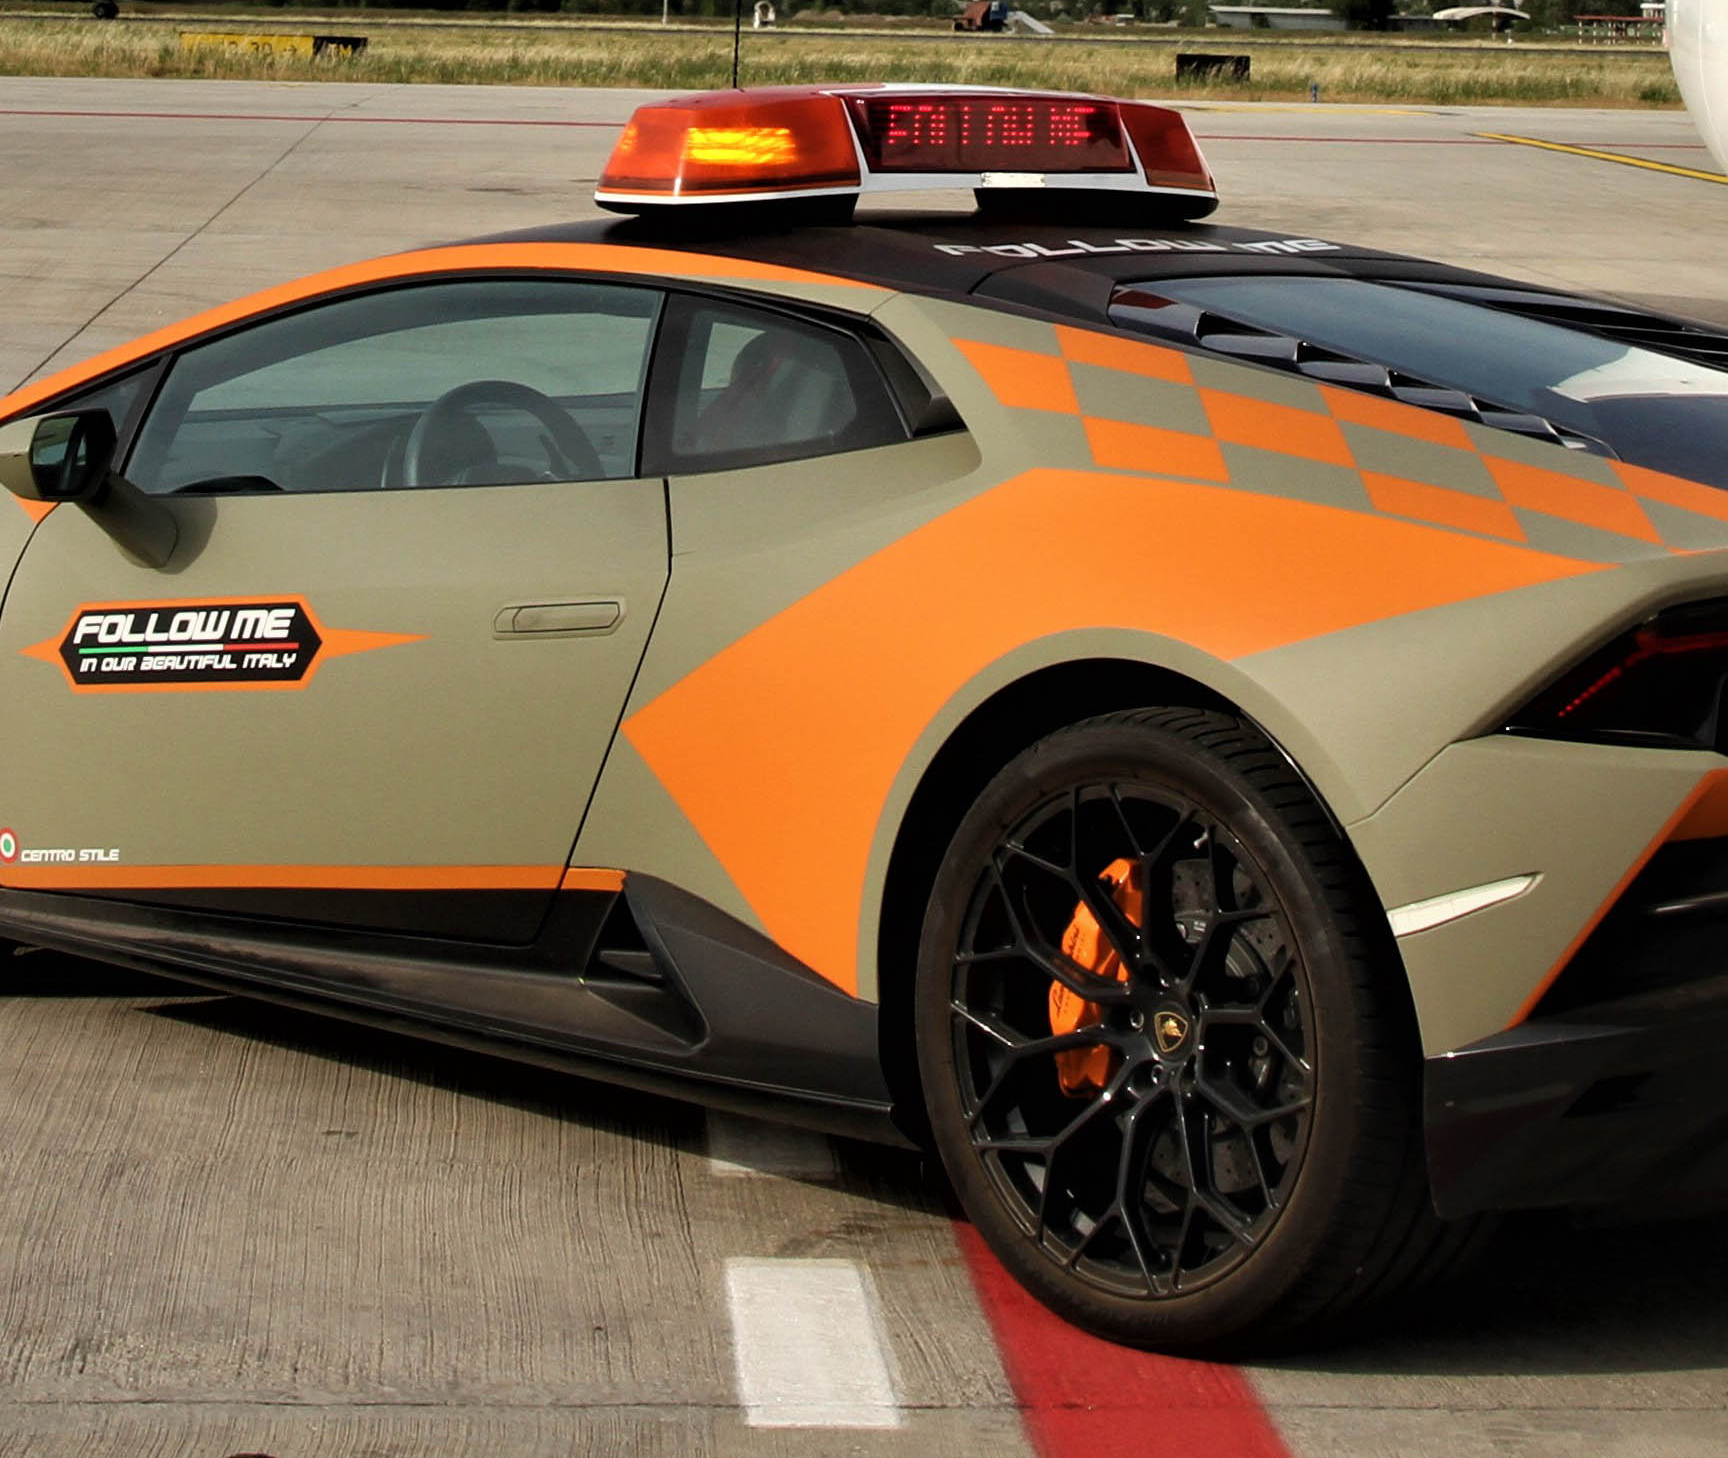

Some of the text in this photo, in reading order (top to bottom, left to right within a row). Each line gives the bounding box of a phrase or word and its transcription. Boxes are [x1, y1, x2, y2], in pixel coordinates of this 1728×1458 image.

[933, 238, 1341, 258] FOLLOW ME
[73, 608, 296, 645] FOLLOW ME
[80, 653, 297, 673] IN OUR BEAUTIFUL ITALY
[21, 848, 120, 862] CENTRO STILE
